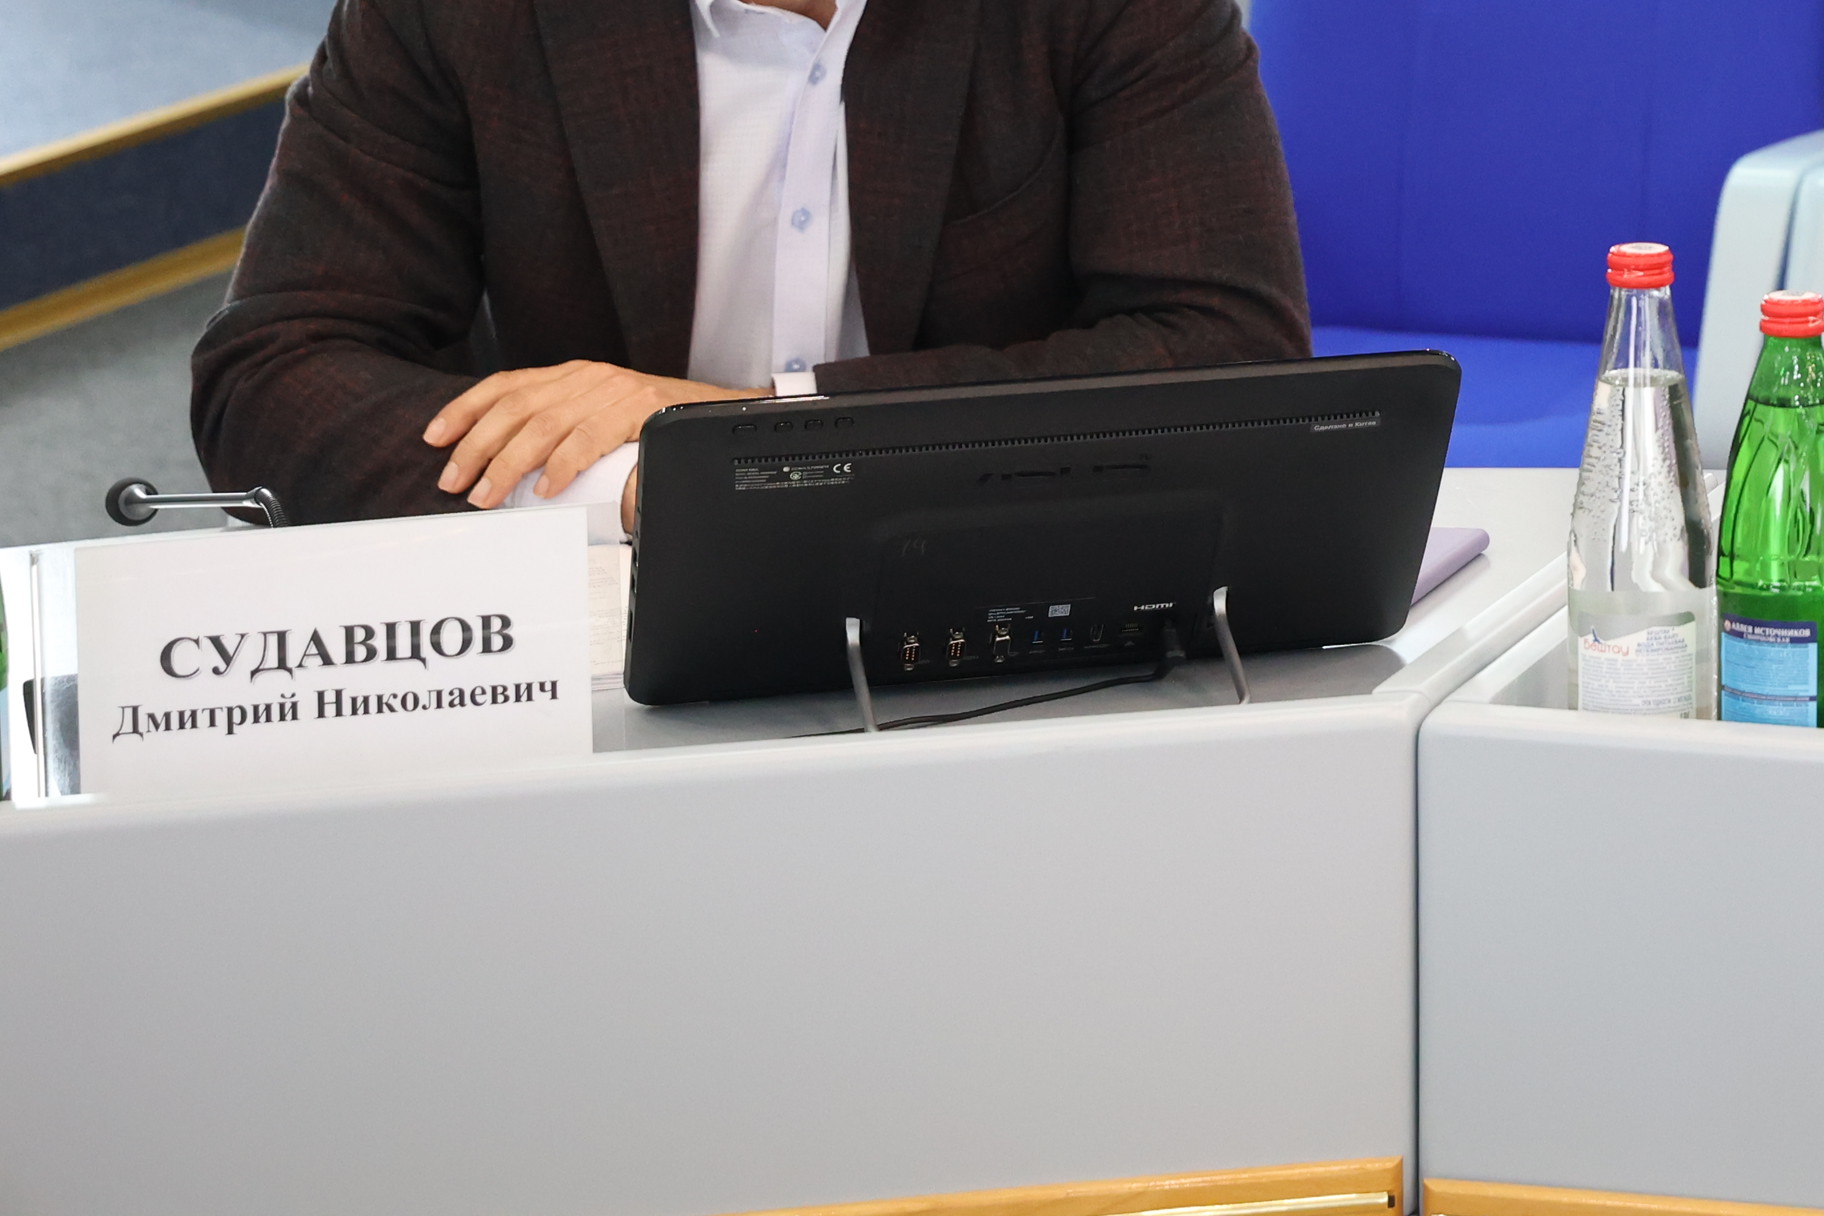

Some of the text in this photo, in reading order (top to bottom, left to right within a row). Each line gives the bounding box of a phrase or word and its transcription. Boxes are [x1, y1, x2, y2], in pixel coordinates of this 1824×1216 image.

[1133, 602, 1174, 611] HDMI
[159, 613, 515, 683] СУДАВЦОВ
[1754, 626, 1811, 637] ИСТОЧНИКОВ
[112, 679, 560, 742] Дмитрий Николаевич
